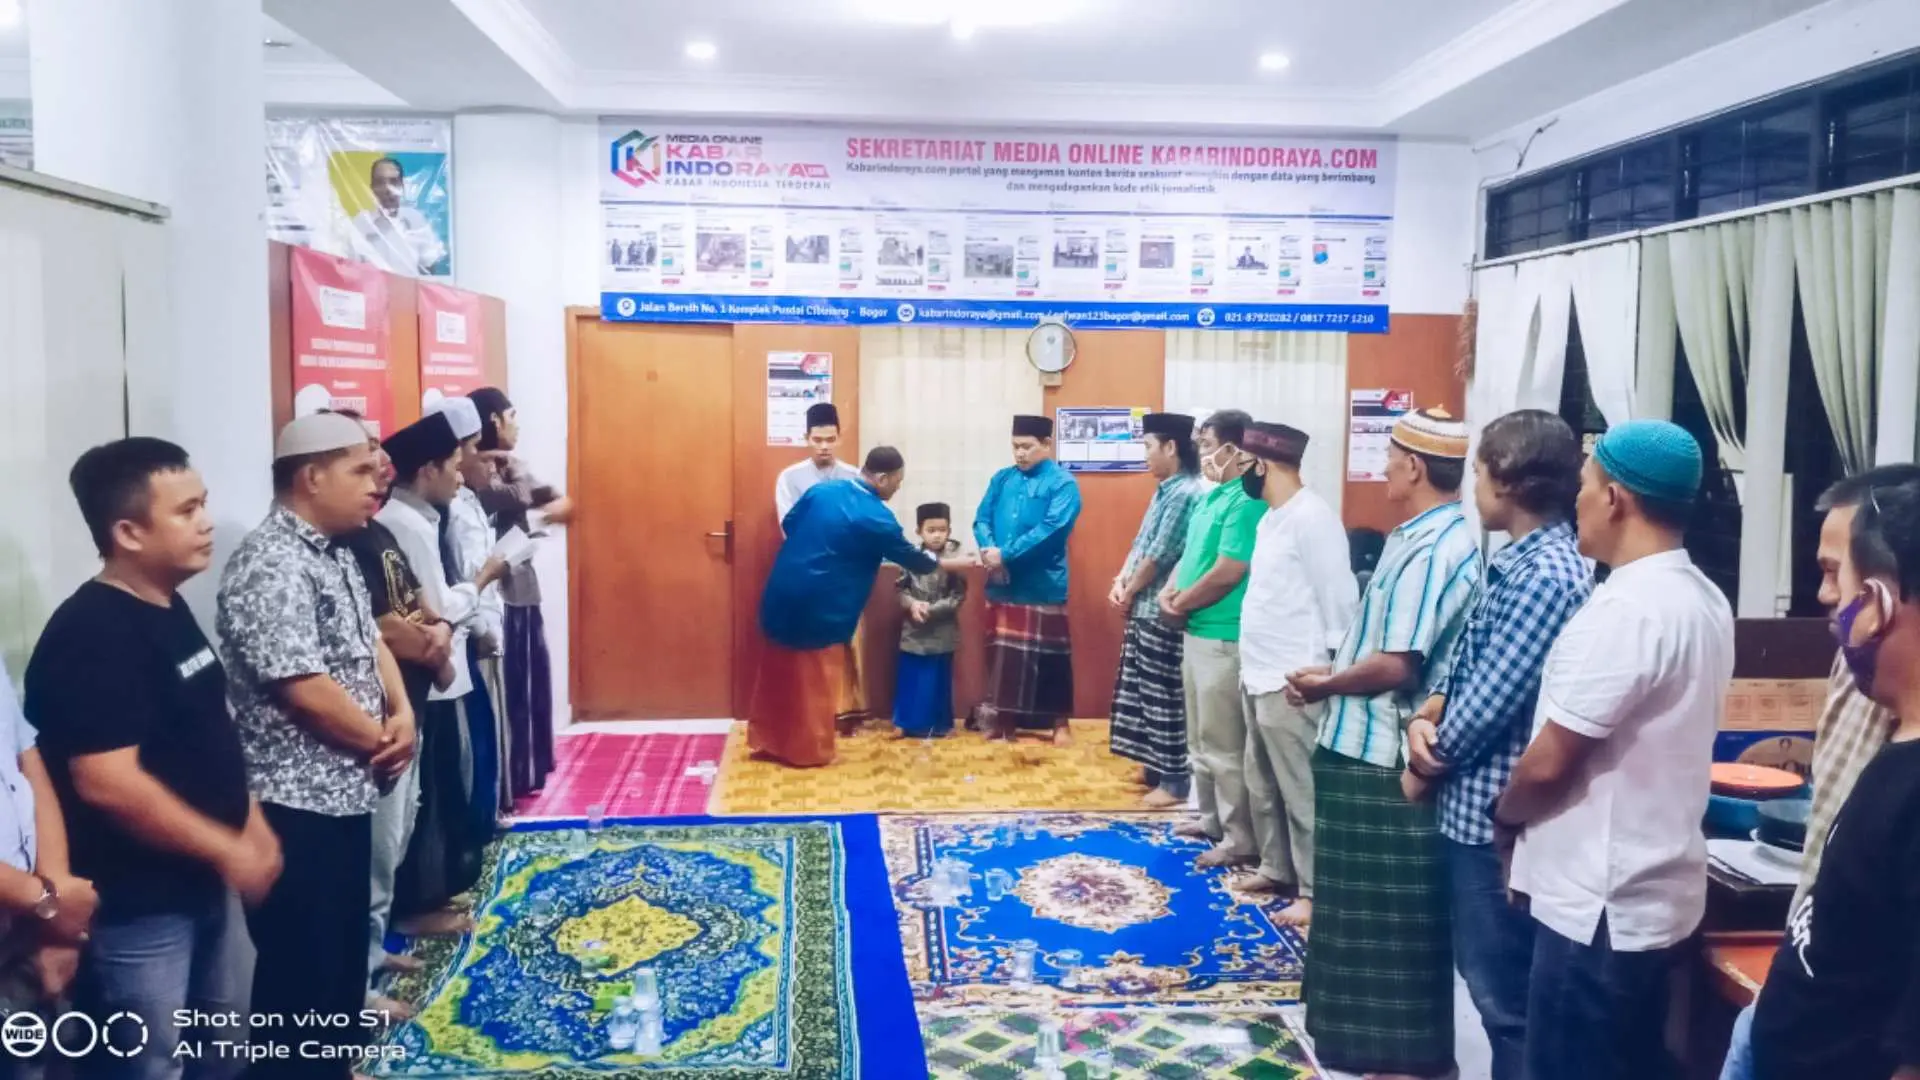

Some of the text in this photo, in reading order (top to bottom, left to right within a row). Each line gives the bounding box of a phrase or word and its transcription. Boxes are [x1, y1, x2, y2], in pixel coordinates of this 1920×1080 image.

[665, 134, 763, 145] MEDIA ONLINE
[665, 144, 763, 159] KABAR
[846, 138, 1378, 169] SEKRETARIAT MEDIA ONLINE KABARINDORAYA.COM
[949, 165, 981, 177] portal
[983, 166, 1009, 178] yang
[1010, 168, 1065, 178] mengemas
[1068, 168, 1103, 178] konten
[1105, 168, 1136, 178] berita
[1231, 171, 1269, 182] dengan
[1271, 172, 1293, 181] data
[1295, 174, 1319, 184] yang
[1322, 173, 1376, 185] berimbang
[664, 178, 831, 190] KABAR INDONESIA TERDEPAN
[1006, 182, 1026, 191] dan
[1113, 184, 1138, 193] kode
[1140, 184, 1160, 193] etik
[640, 302, 666, 312] Jalan
[667, 302, 699, 313] Bersih
[701, 304, 718, 314] No.
[728, 304, 771, 316] Komplek
[860, 307, 888, 318] Bogor
